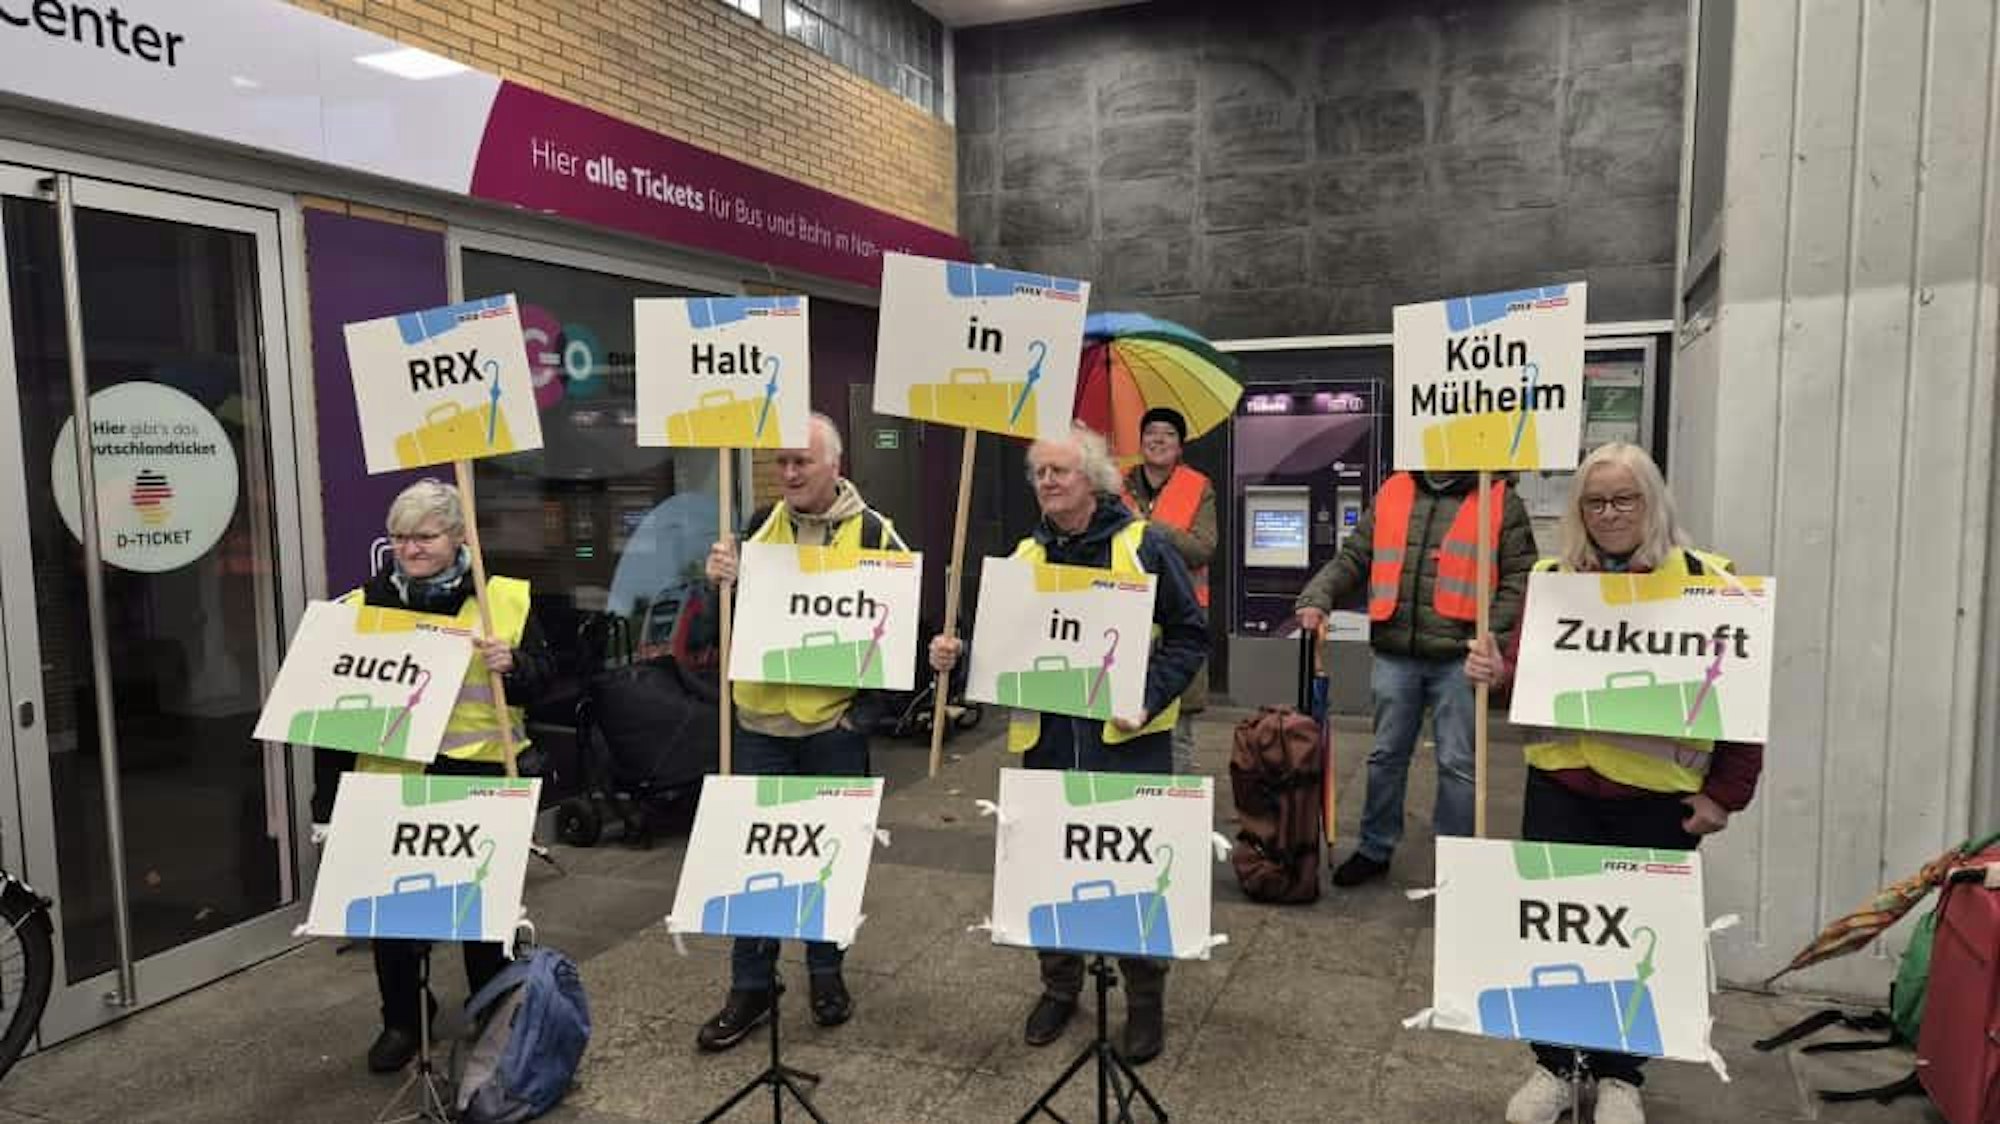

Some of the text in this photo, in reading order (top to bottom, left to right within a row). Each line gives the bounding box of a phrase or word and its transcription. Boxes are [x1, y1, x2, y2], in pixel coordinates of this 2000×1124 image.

[531, 135, 580, 177] Hier
[585, 155, 628, 191] alle
[632, 166, 705, 212] Tickets
[709, 188, 731, 219] für
[735, 198, 763, 228] Bus
[767, 211, 796, 238] und
[799, 216, 832, 249] Bahn
[967, 316, 1003, 354] in
[1447, 333, 1527, 372] Köln
[408, 349, 484, 393] RRX
[691, 343, 762, 375] Halt
[1411, 375, 1566, 417] Mülheim
[94, 421, 126, 435] Hier
[94, 441, 217, 456] utschlandticket
[117, 529, 193, 548] D-TICKET
[790, 590, 877, 619] noch
[1050, 608, 1081, 642] in
[1554, 618, 1750, 659] Zukunft
[333, 654, 419, 685] auch
[391, 822, 480, 858] RRX
[745, 822, 825, 857] RRX
[1064, 823, 1153, 865] RRX
[1519, 899, 1631, 948] RRX
